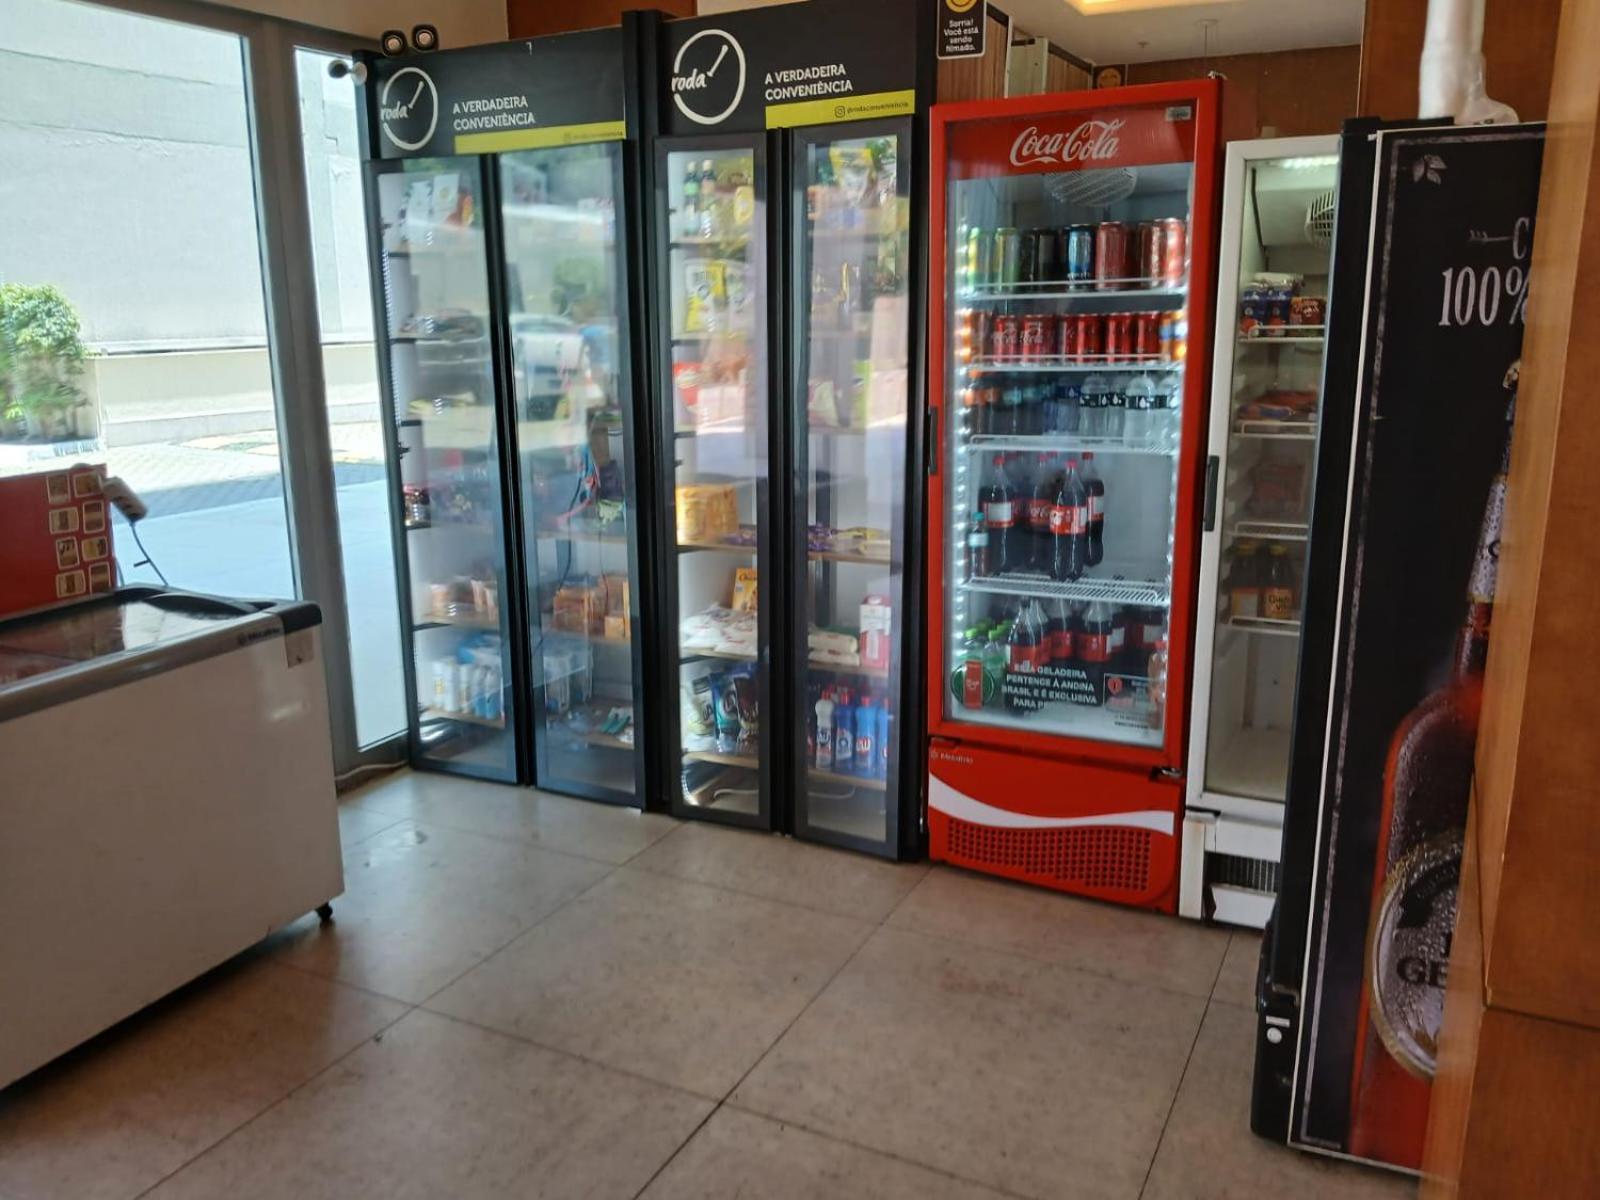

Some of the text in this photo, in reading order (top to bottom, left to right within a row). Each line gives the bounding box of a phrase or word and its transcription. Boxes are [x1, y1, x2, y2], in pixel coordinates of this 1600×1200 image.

[672, 69, 707, 91] roda
[765, 64, 846, 85] A VERDADEIRA
[765, 80, 853, 101] CONVENIÊNCIA
[380, 101, 408, 121] roda
[453, 96, 528, 114] A VERDADEIRA
[453, 112, 535, 131] CONVENIÊNCIA
[1009, 118, 1126, 167] Coca-Cola
[1437, 265, 1531, 326] 100%
[1006, 674, 1051, 687] PERTENCE
[1061, 682, 1095, 692] ANDINA
[1037, 666, 1088, 680] GELADEIRA
[1001, 685, 1031, 696] BRASIL
[1033, 689, 1040, 698] E
[1049, 690, 1098, 705] EXCLUSIVA
[1013, 697, 1037, 709] PARA
